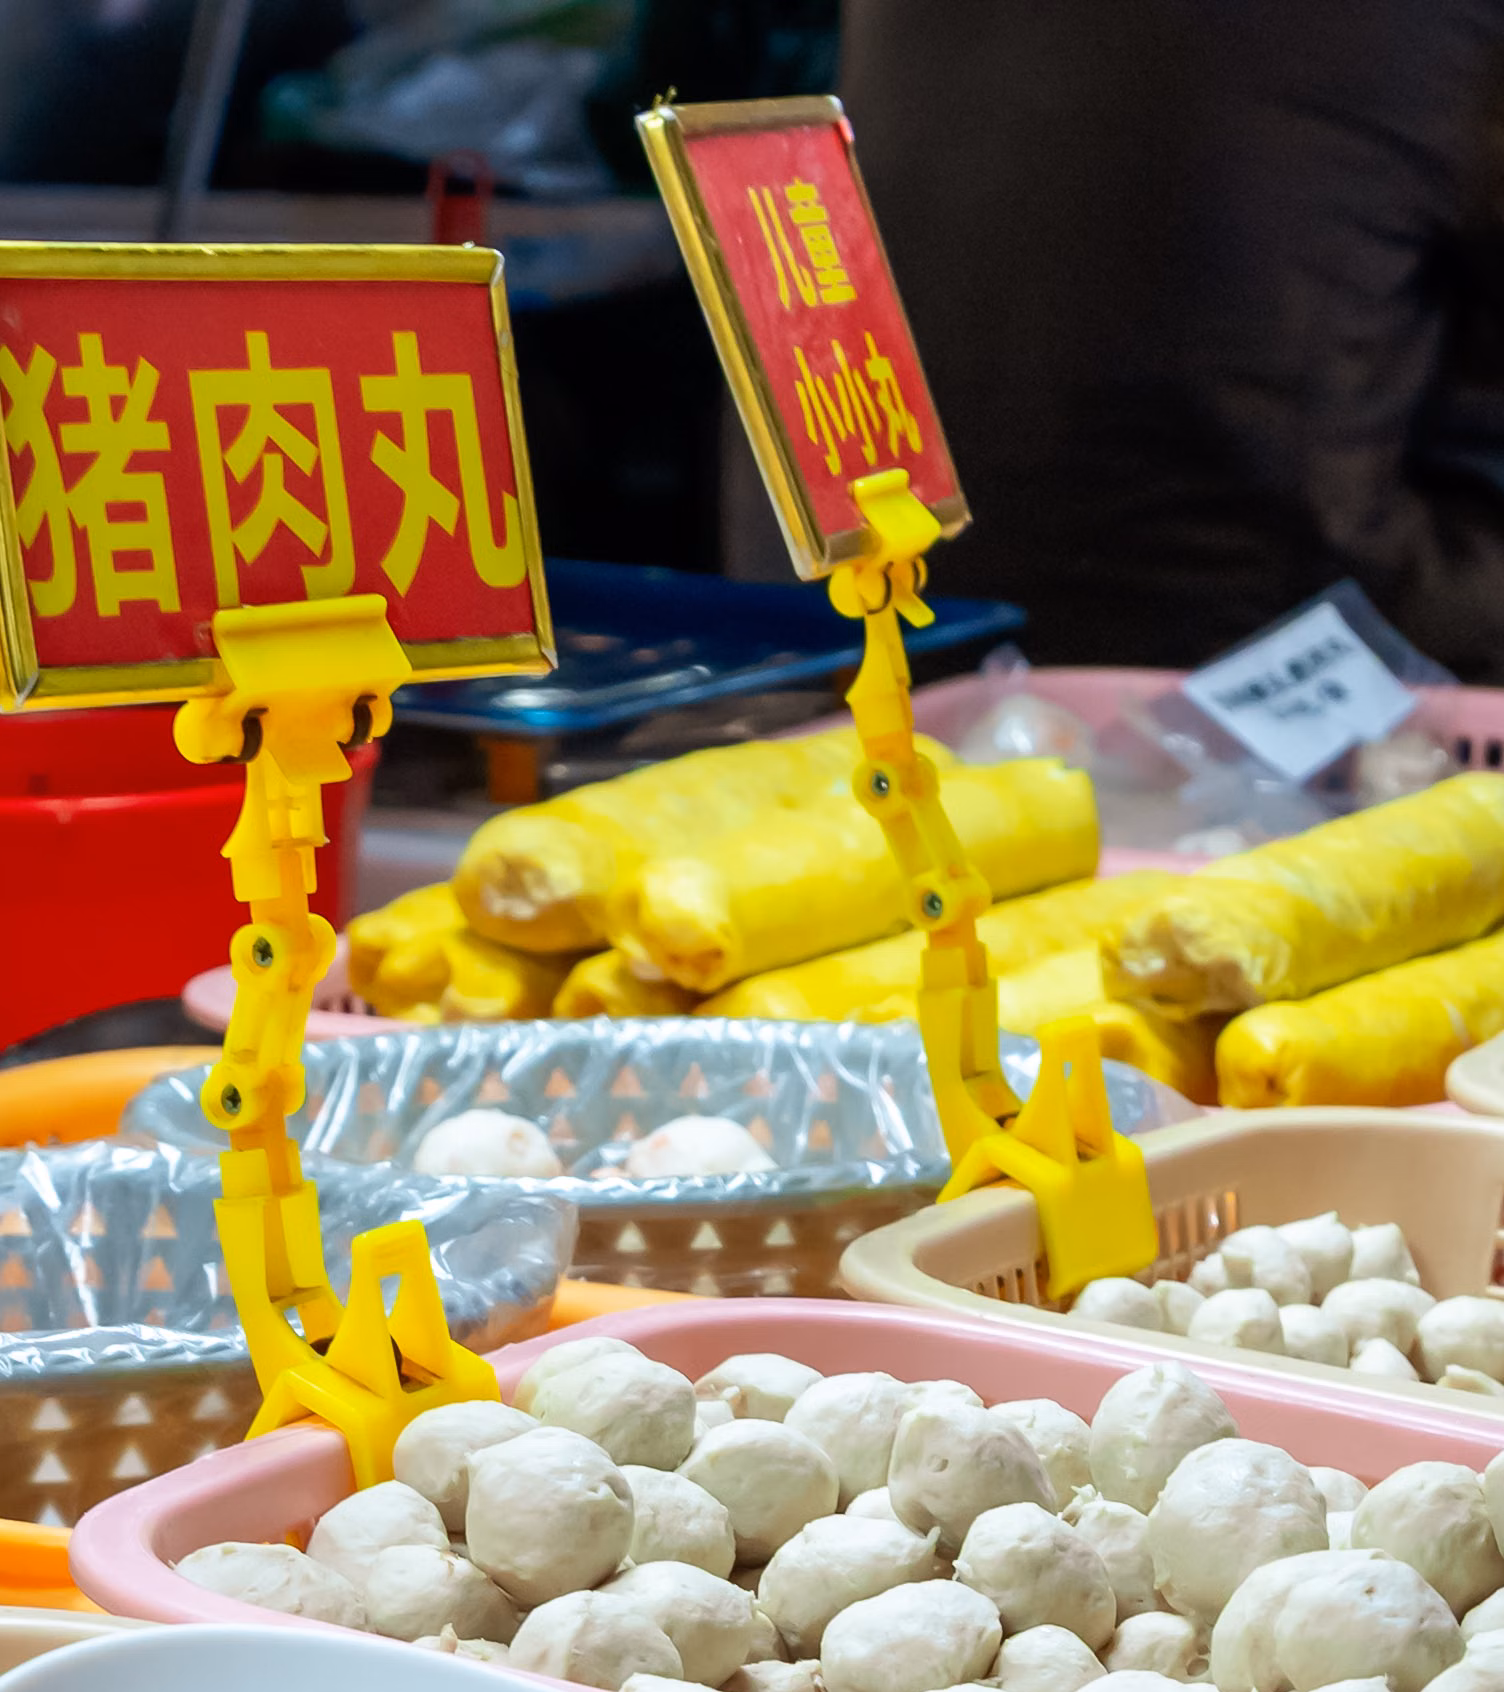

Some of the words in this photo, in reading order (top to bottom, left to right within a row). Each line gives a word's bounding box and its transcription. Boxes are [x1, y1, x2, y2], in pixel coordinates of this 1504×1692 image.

[747, 176, 858, 309] 儿童
[793, 329, 923, 478] 小小丸
